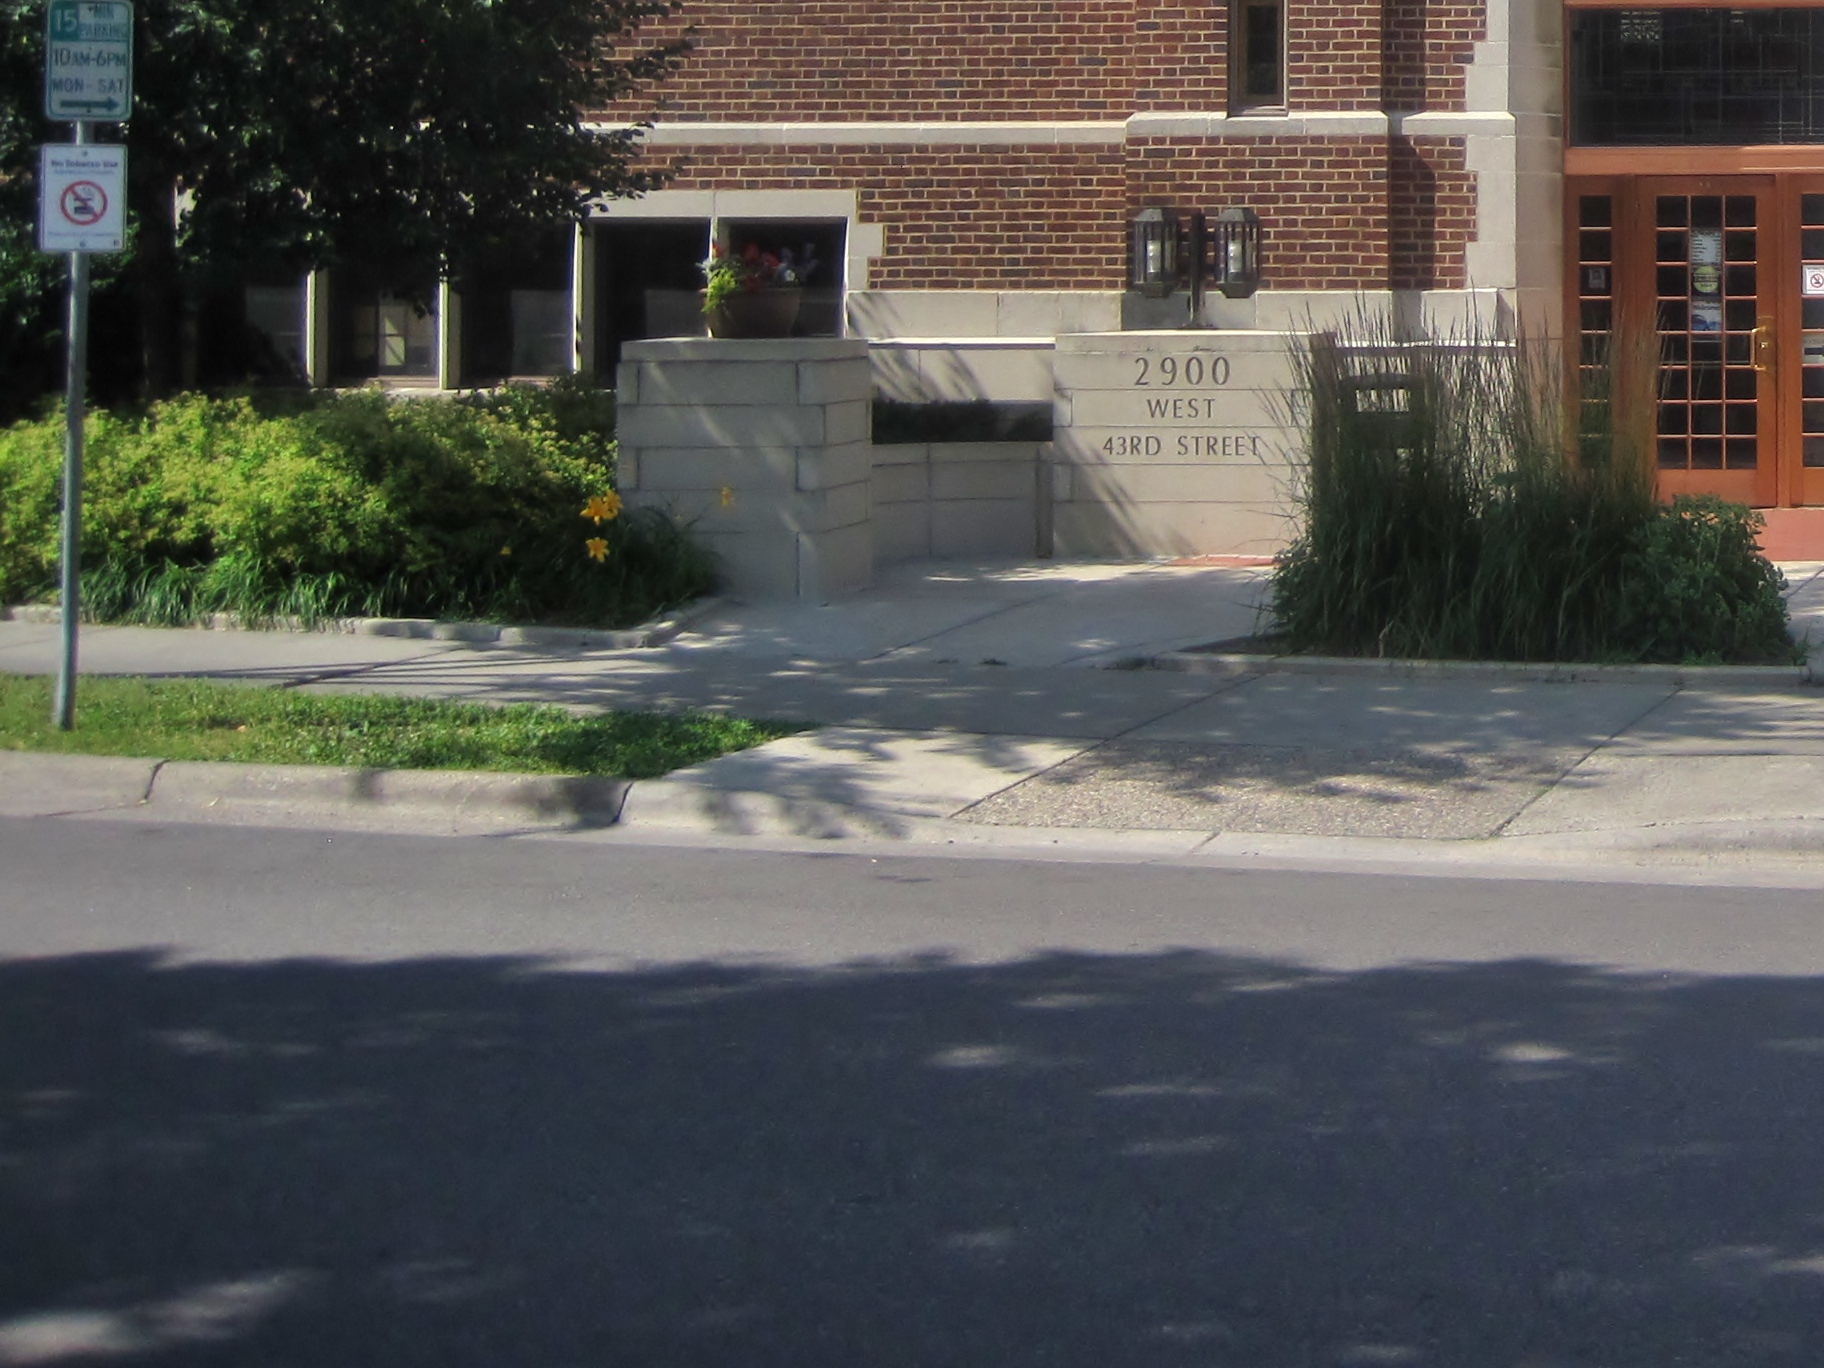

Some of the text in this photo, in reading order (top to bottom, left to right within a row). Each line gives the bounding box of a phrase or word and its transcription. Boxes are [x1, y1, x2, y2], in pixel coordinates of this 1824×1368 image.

[56, 8, 77, 32] 15
[52, 78, 83, 92] MON
[99, 78, 124, 92] SAT
[1134, 356, 1231, 386] 2900
[1147, 398, 1215, 419] WEST
[1102, 435, 1260, 457] 43RD STREET
